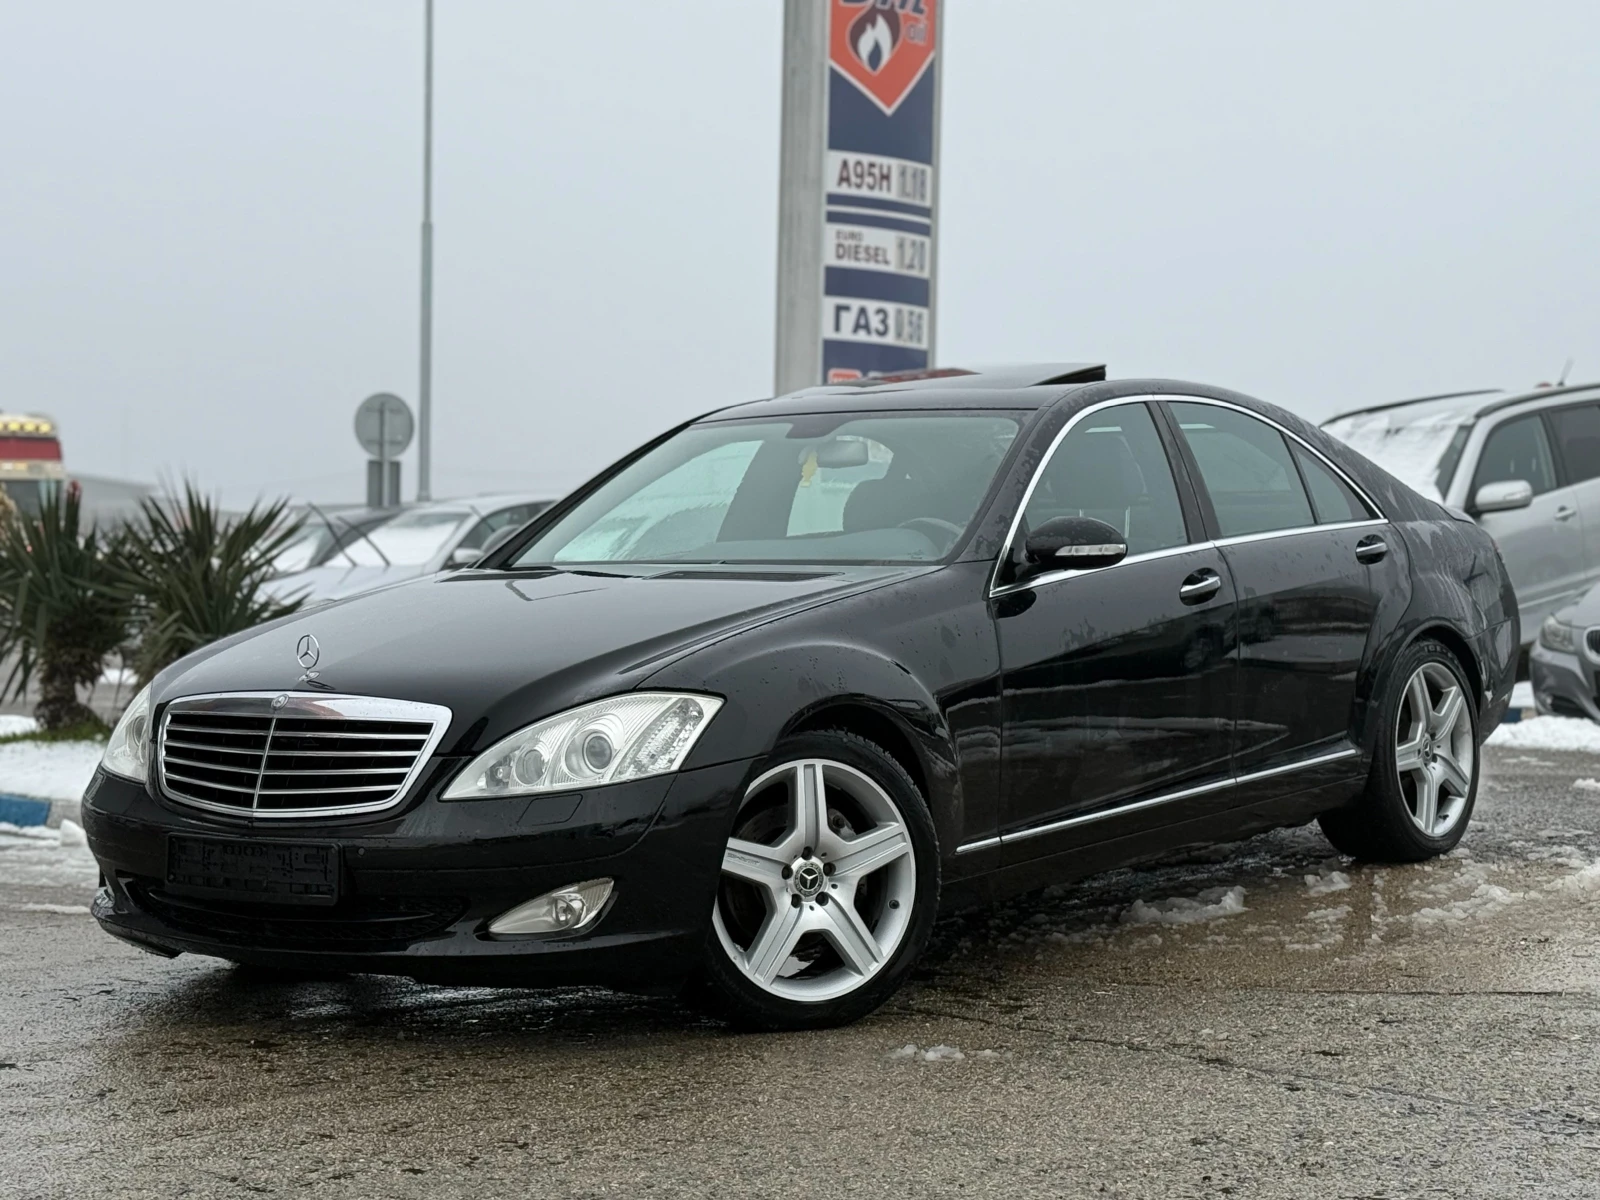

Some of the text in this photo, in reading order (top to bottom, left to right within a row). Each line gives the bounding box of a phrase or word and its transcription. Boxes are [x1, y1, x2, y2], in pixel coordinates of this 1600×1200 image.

[836, 230, 863, 242] EURO
[836, 243, 890, 266] DIESEL
[834, 304, 889, 337] ГАЗ
